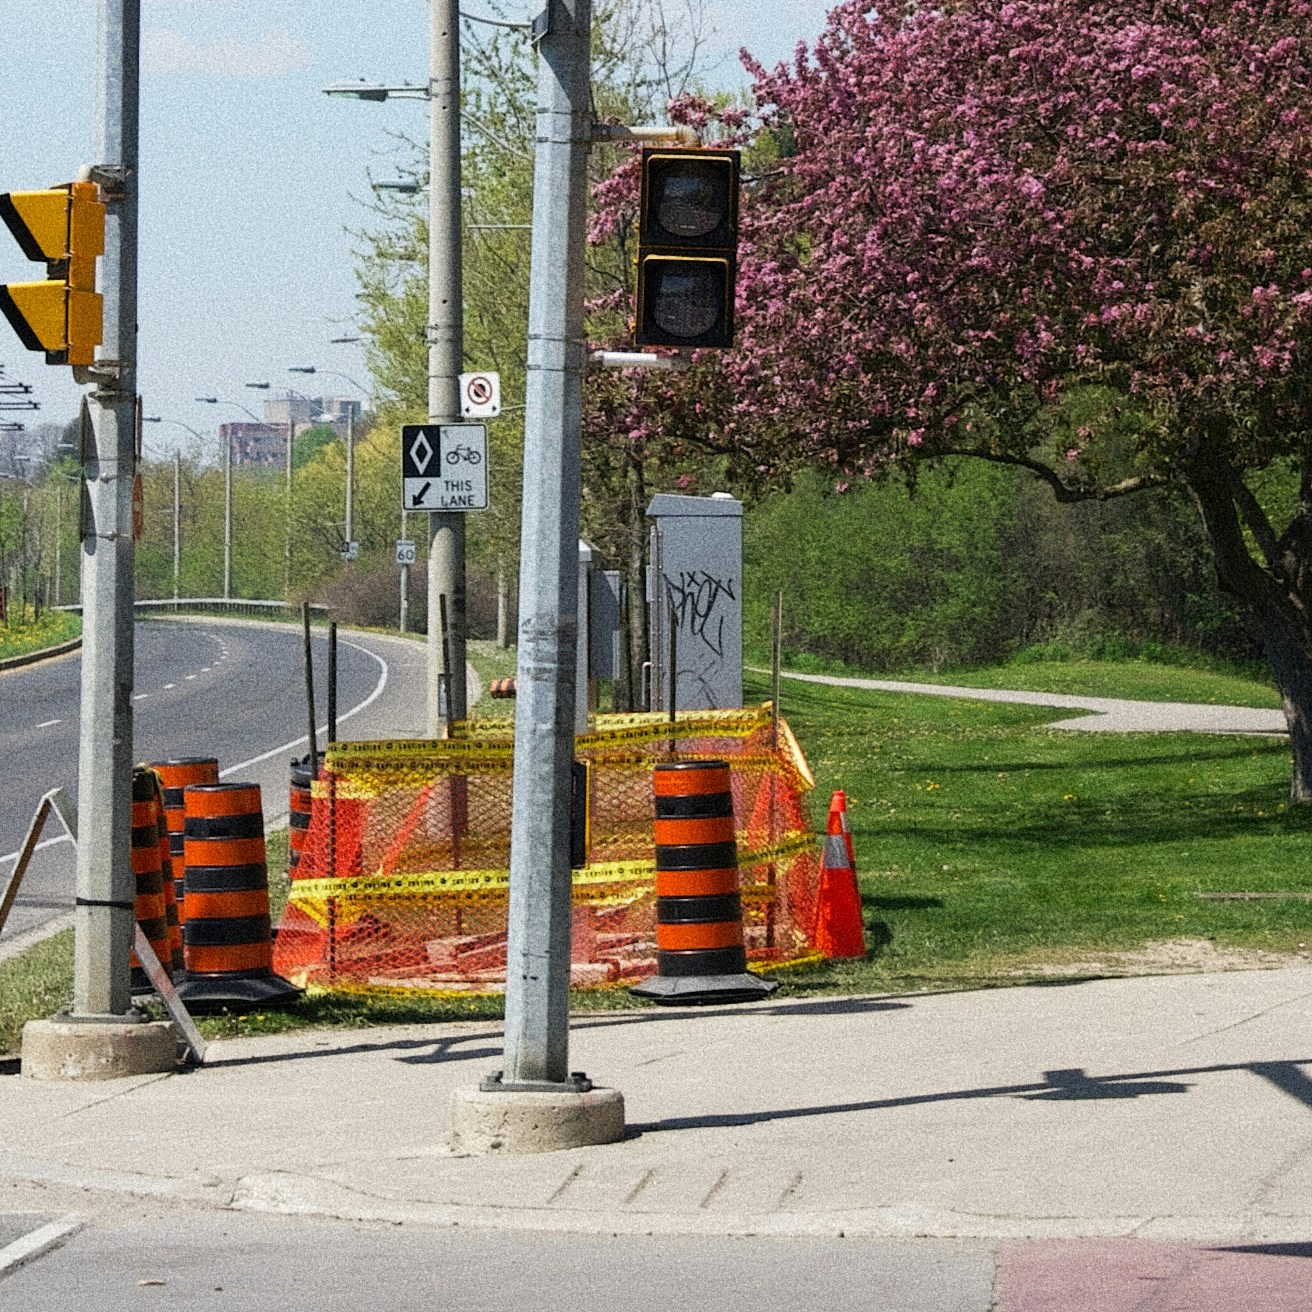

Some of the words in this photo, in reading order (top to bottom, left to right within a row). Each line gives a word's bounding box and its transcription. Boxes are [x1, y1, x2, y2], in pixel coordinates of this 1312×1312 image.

[444, 480, 472, 492] THIS
[440, 495, 475, 507] LANE
[397, 548, 414, 561] 60
